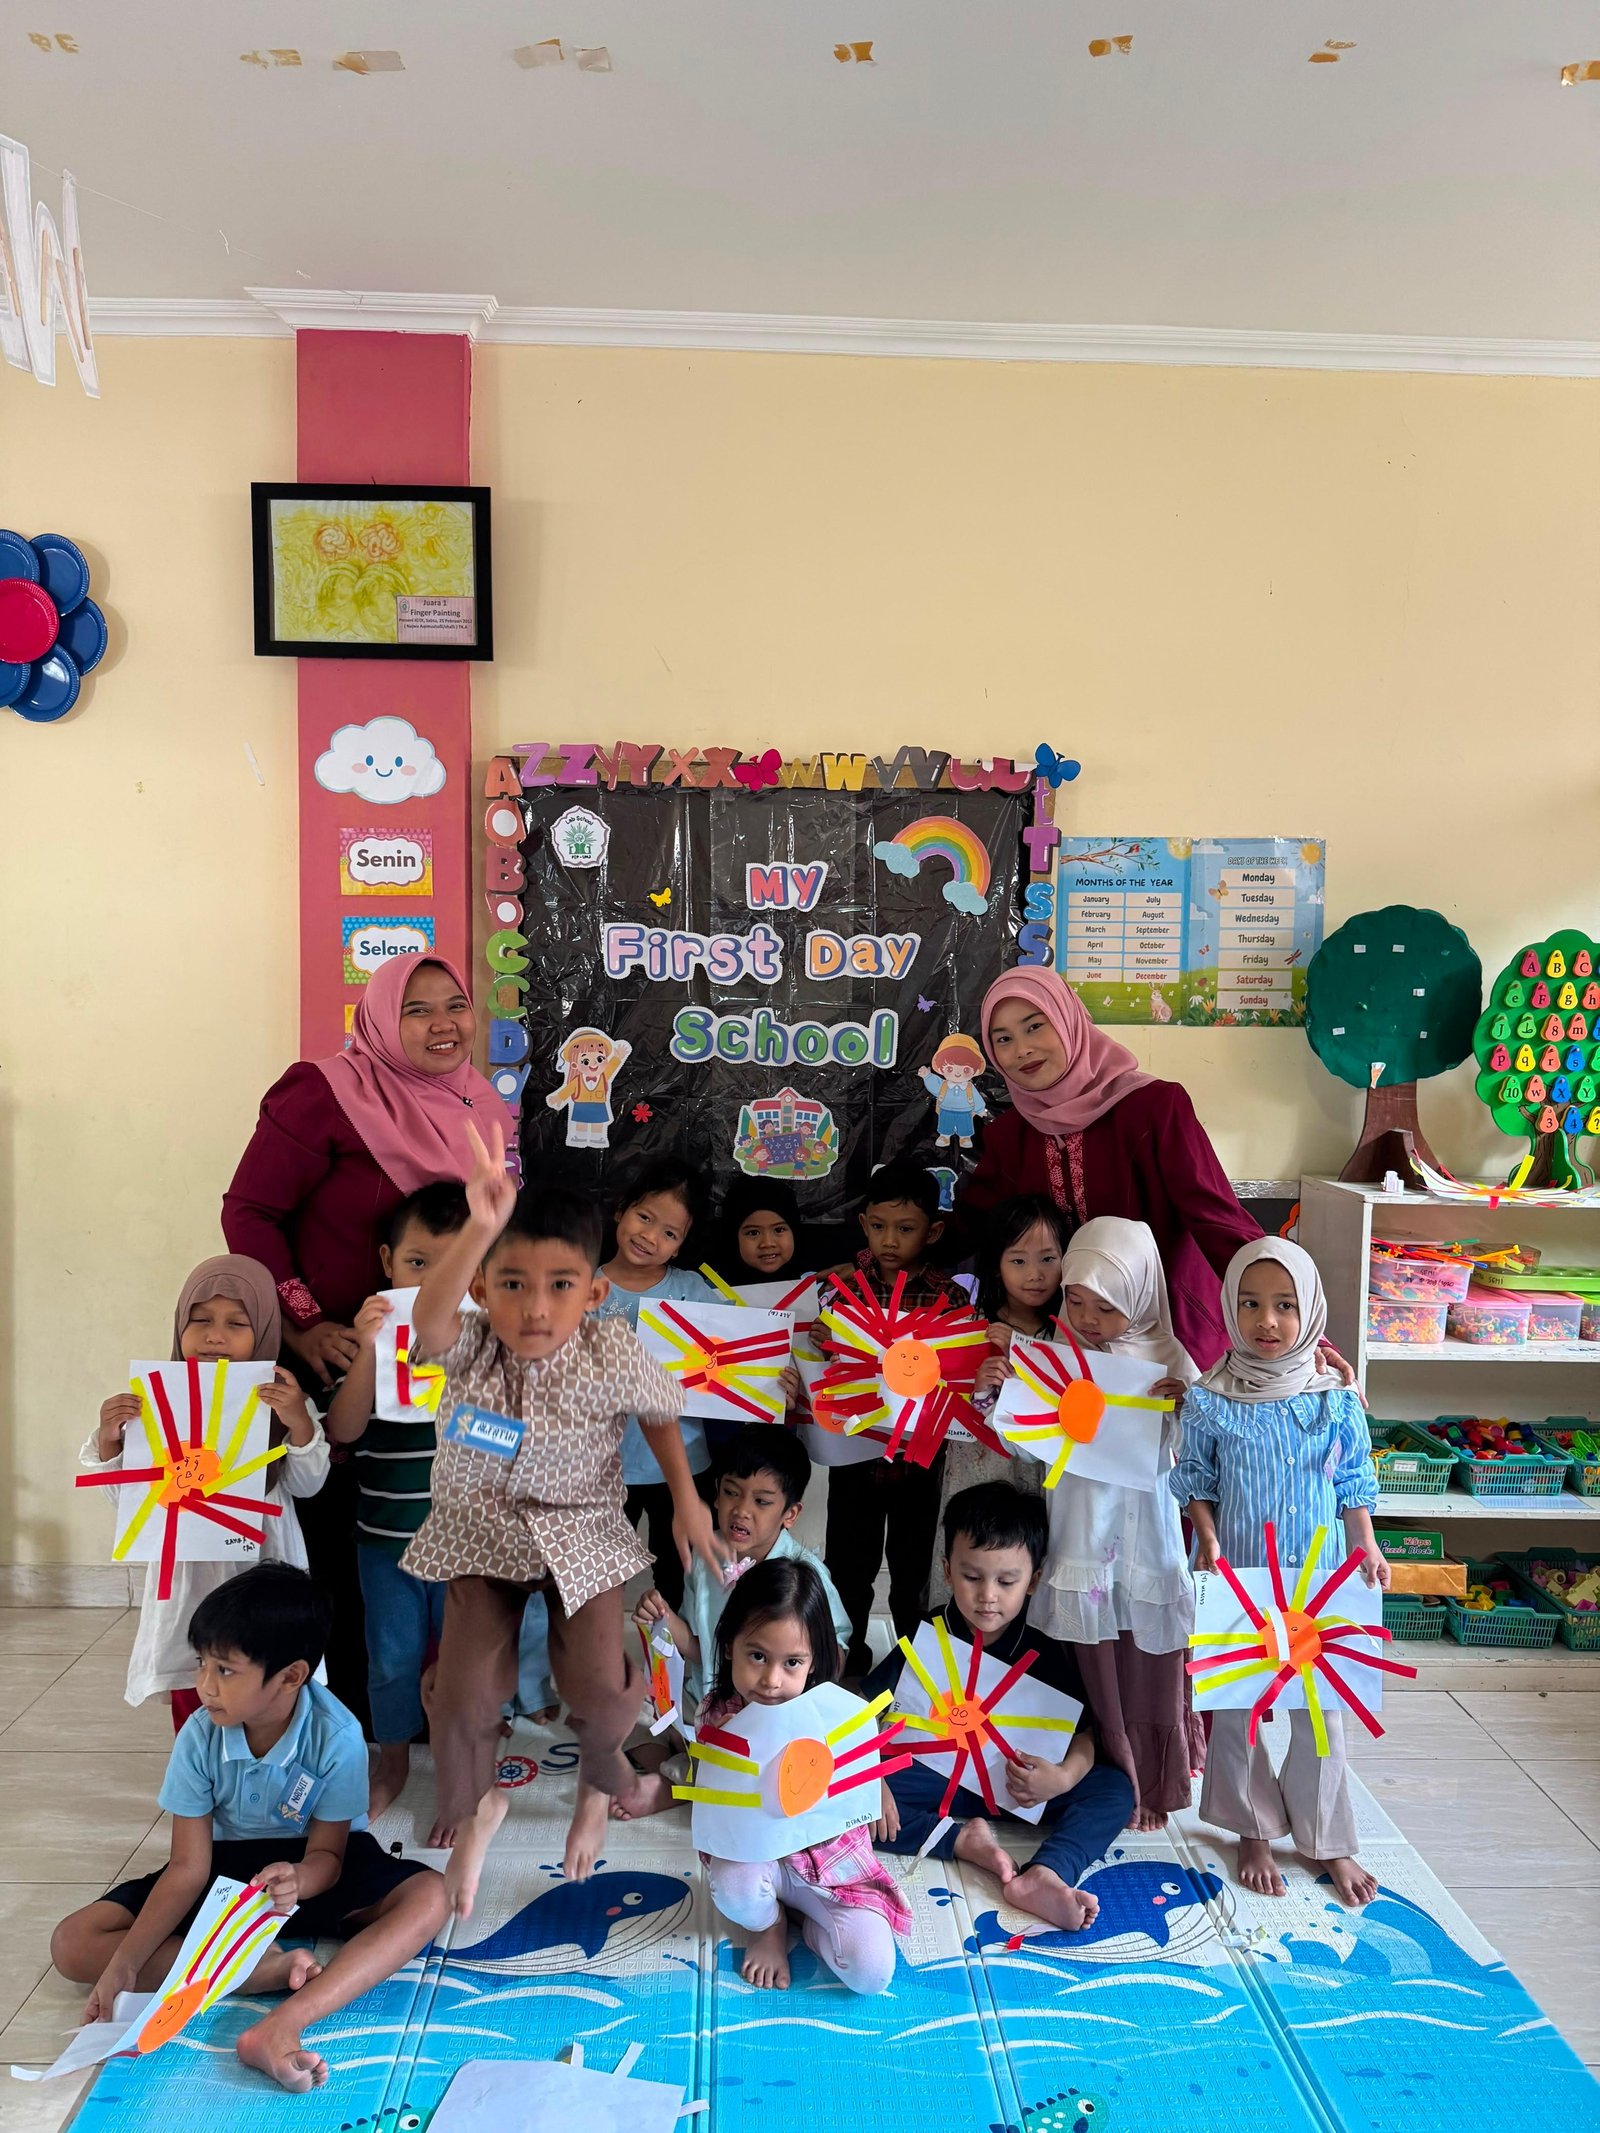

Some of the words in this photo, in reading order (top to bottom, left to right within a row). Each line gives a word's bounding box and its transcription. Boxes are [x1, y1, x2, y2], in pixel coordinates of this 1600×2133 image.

[356, 848, 416, 868] Senin
[1076, 878, 1114, 886] MONTHS
[1116, 878, 1127, 886] OF
[1242, 873, 1275, 884] Monday
[1083, 896, 1109, 904] January
[1146, 896, 1161, 905] July
[1241, 893, 1274, 905] Tuesday
[1081, 911, 1110, 920] February
[1142, 912, 1164, 920] August
[1235, 914, 1279, 925] Wednesday
[1136, 926, 1169, 935] September
[1238, 934, 1275, 945] Thursday
[359, 940, 419, 956] Selasa
[1088, 941, 1103, 950] April
[606, 925, 782, 982] First
[809, 932, 918, 978] Day
[1088, 956, 1102, 965] May
[1243, 955, 1269, 966] Friday
[1527, 962, 1536, 973] A
[1553, 962, 1561, 973] B
[1580, 962, 1588, 973] C
[1236, 975, 1273, 987] Saturday
[1240, 995, 1268, 1006] Sunday
[1538, 995, 1546, 1004] F
[1564, 995, 1572, 1006] g
[1588, 994, 1596, 1005] h
[1551, 1026, 1559, 1036] 8
[1572, 1027, 1584, 1035] m
[673, 1010, 896, 1066] School
[1506, 1087, 1519, 1098] 10
[1546, 1118, 1553, 1128] 3
[1570, 1119, 1577, 1129] 4
[1380, 1539, 1406, 1553] Puzzle
[1408, 1546, 1435, 1555] Blocks
